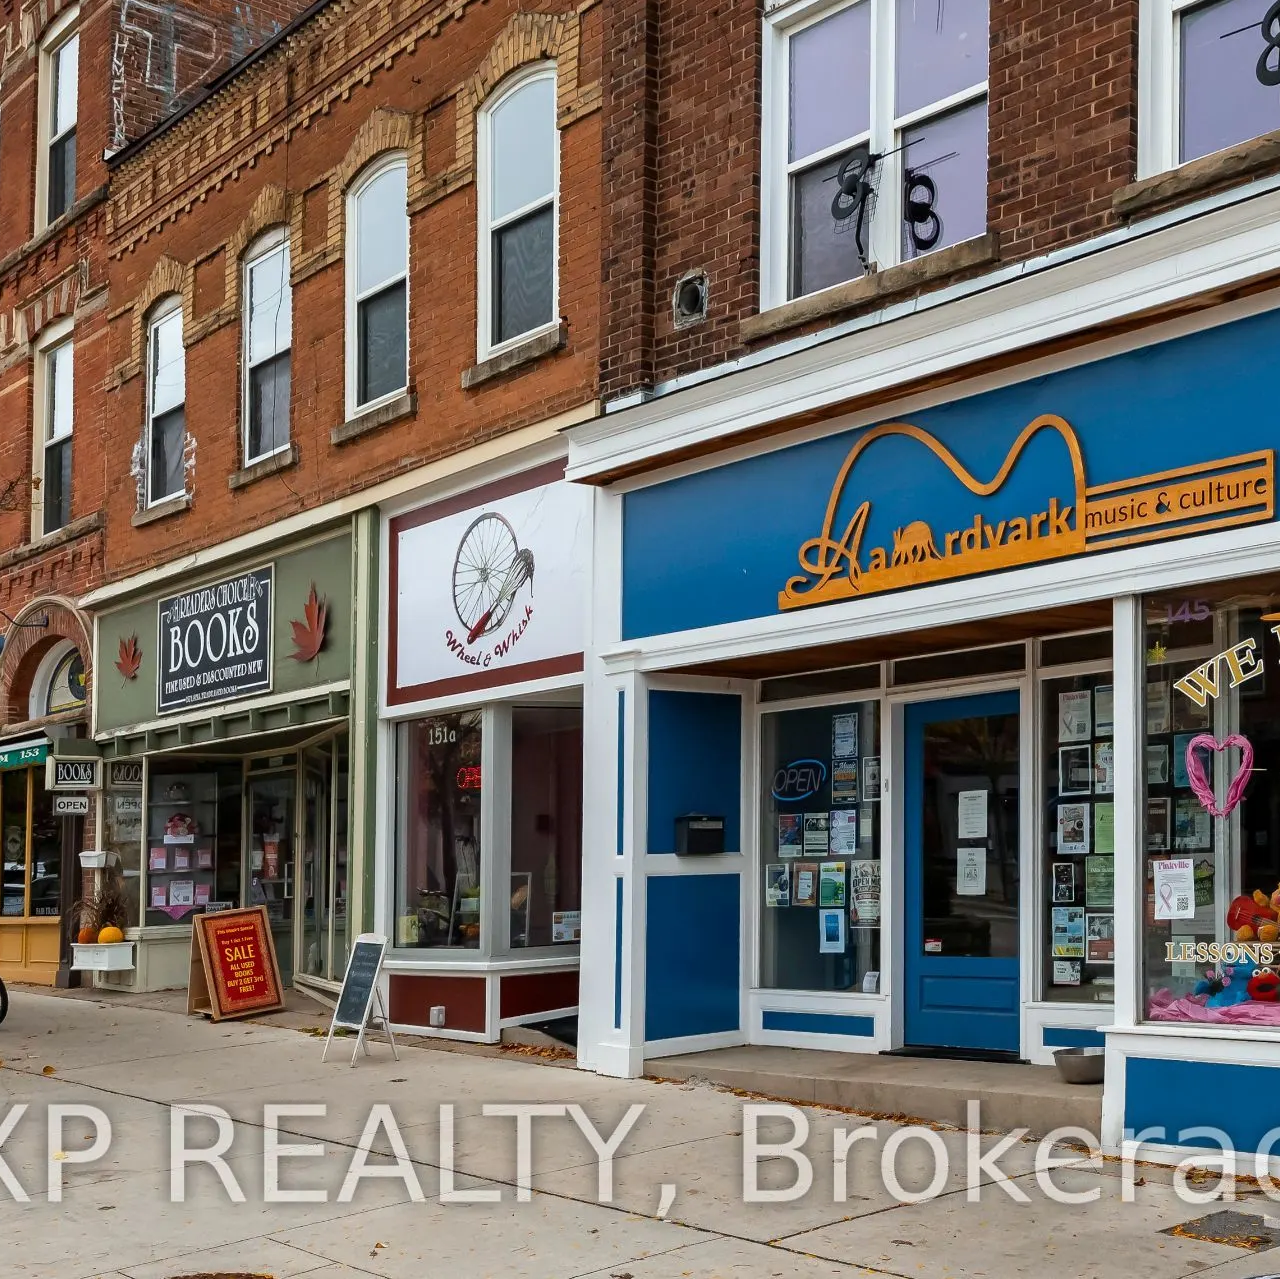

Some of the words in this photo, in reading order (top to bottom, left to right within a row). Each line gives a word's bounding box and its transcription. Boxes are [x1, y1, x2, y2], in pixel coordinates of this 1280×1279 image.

[1085, 497, 1148, 529] music
[1154, 491, 1171, 514] &
[1179, 473, 1268, 510] culture
[179, 587, 217, 619] READERS
[216, 577, 248, 608] CHOICE
[1166, 600, 1210, 622] 145
[169, 600, 260, 672] BOOKS
[445, 630, 482, 666] Wheel
[483, 652, 492, 667] &
[494, 604, 534, 658] Whisk
[165, 679, 179, 694] FINE
[178, 675, 195, 691] USED
[195, 673, 202, 687] &
[202, 663, 247, 685] DISCOUNTED
[248, 659, 263, 675] NEW
[1173, 637, 1265, 709] WE
[428, 729, 456, 745] 151a
[19, 747, 40, 759] 153
[57, 763, 92, 781] BOOKS
[773, 769, 821, 792] OPEN
[57, 801, 87, 810] OPEN
[1158, 861, 1190, 870] Pinkville
[224, 944, 255, 962] SALE
[1165, 942, 1274, 964] LESSONS
[230, 963, 240, 971] ALL
[241, 961, 255, 969] USED
[234, 969, 253, 978] BOOKS
[227, 979, 238, 987] BUY
[243, 976, 252, 985] GET
